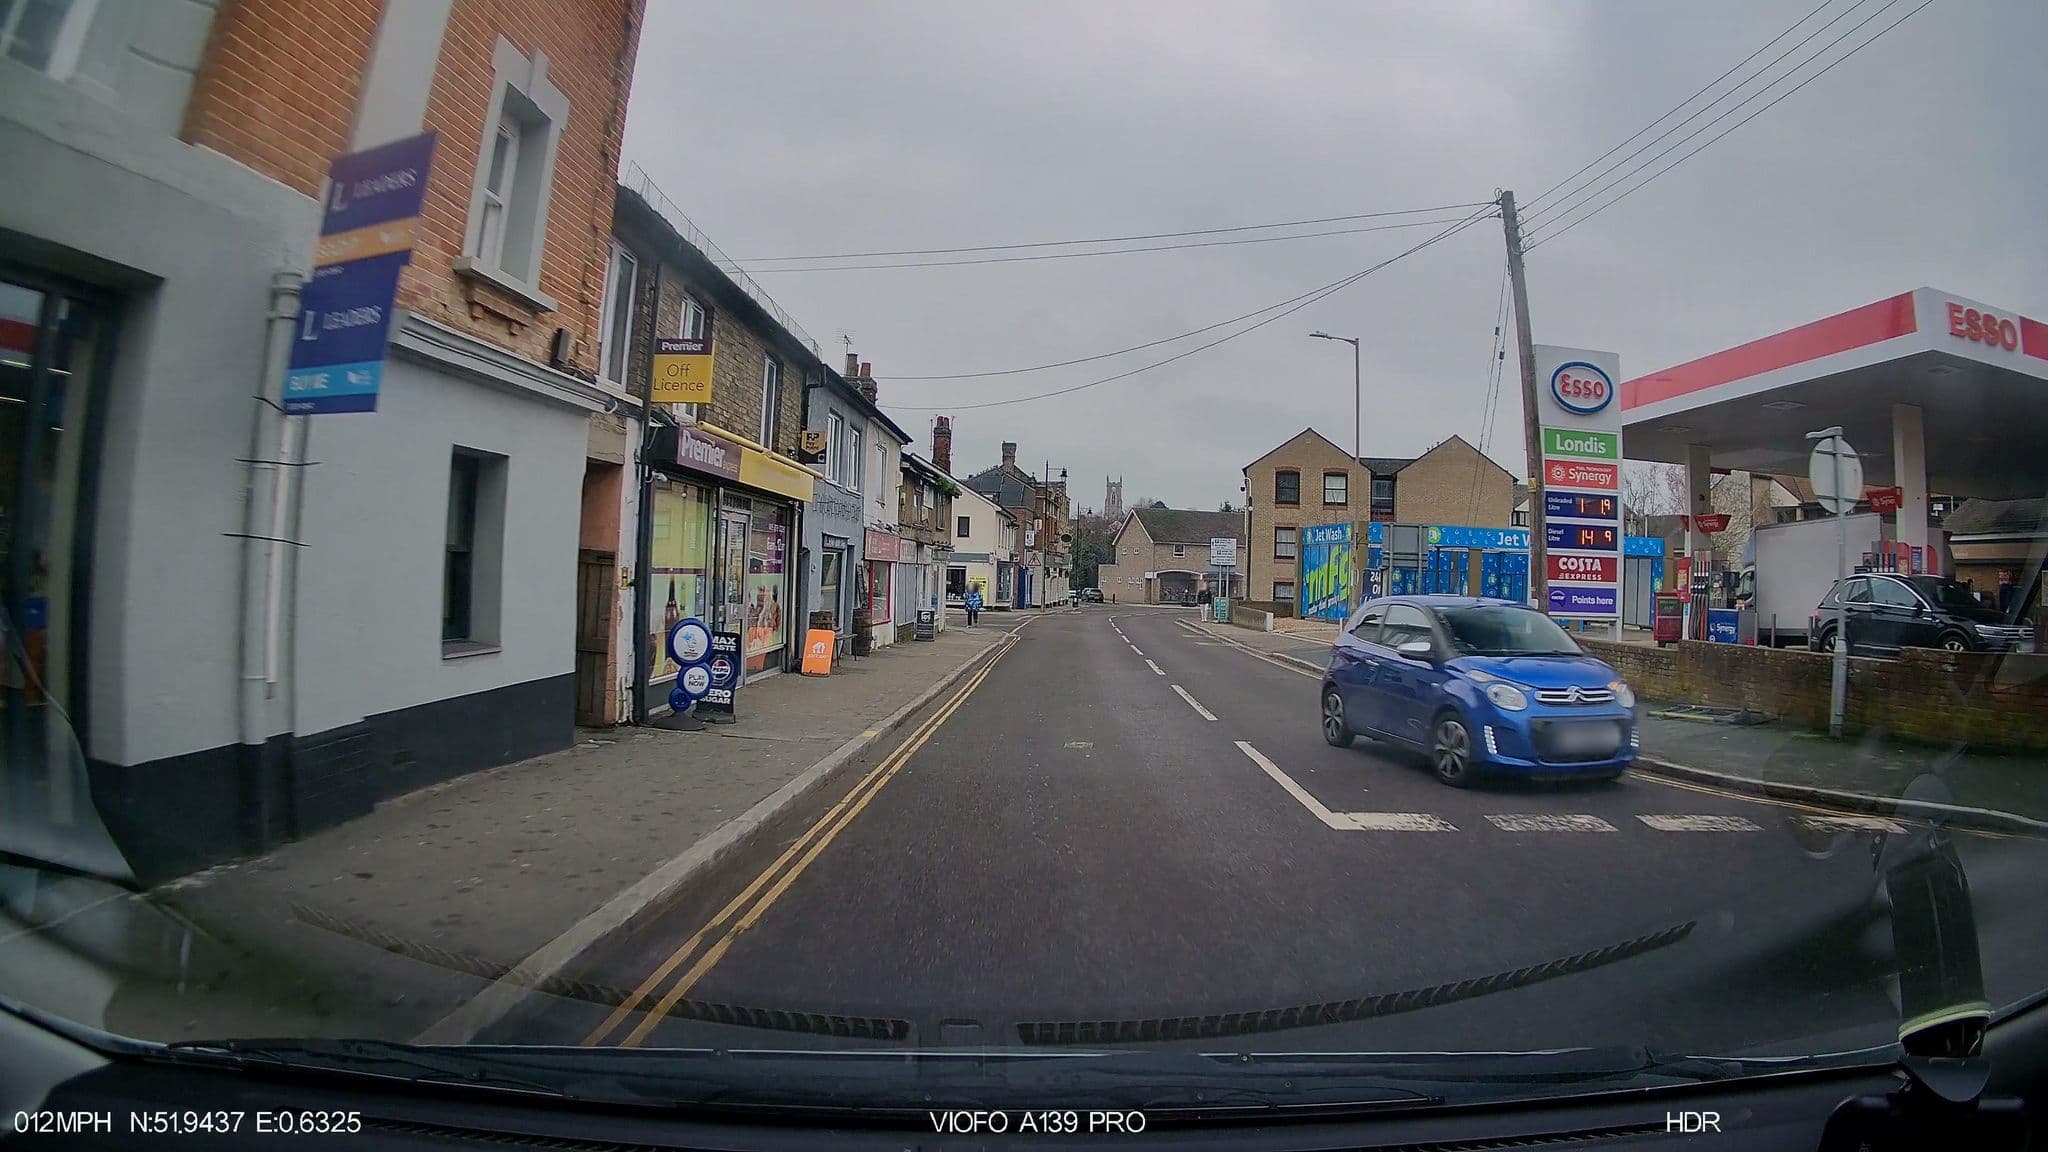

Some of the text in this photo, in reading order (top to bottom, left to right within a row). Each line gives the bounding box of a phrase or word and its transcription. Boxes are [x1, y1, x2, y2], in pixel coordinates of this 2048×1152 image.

[1948, 302, 2018, 351] ESSO
[661, 341, 704, 351] Premier
[666, 363, 691, 377] Off
[653, 377, 704, 391] Licence
[681, 429, 725, 468] Premier
[1556, 433, 1607, 454] Londis
[1568, 468, 1612, 485] Synergy
[1315, 527, 1342, 541] Jet Wash
[1497, 532, 1519, 546] Jet
[1558, 557, 1602, 572] COSTA
[1571, 595, 1614, 605] Points here
[1716, 623, 1737, 634] Synergy
[708, 689, 732, 697] ERO
